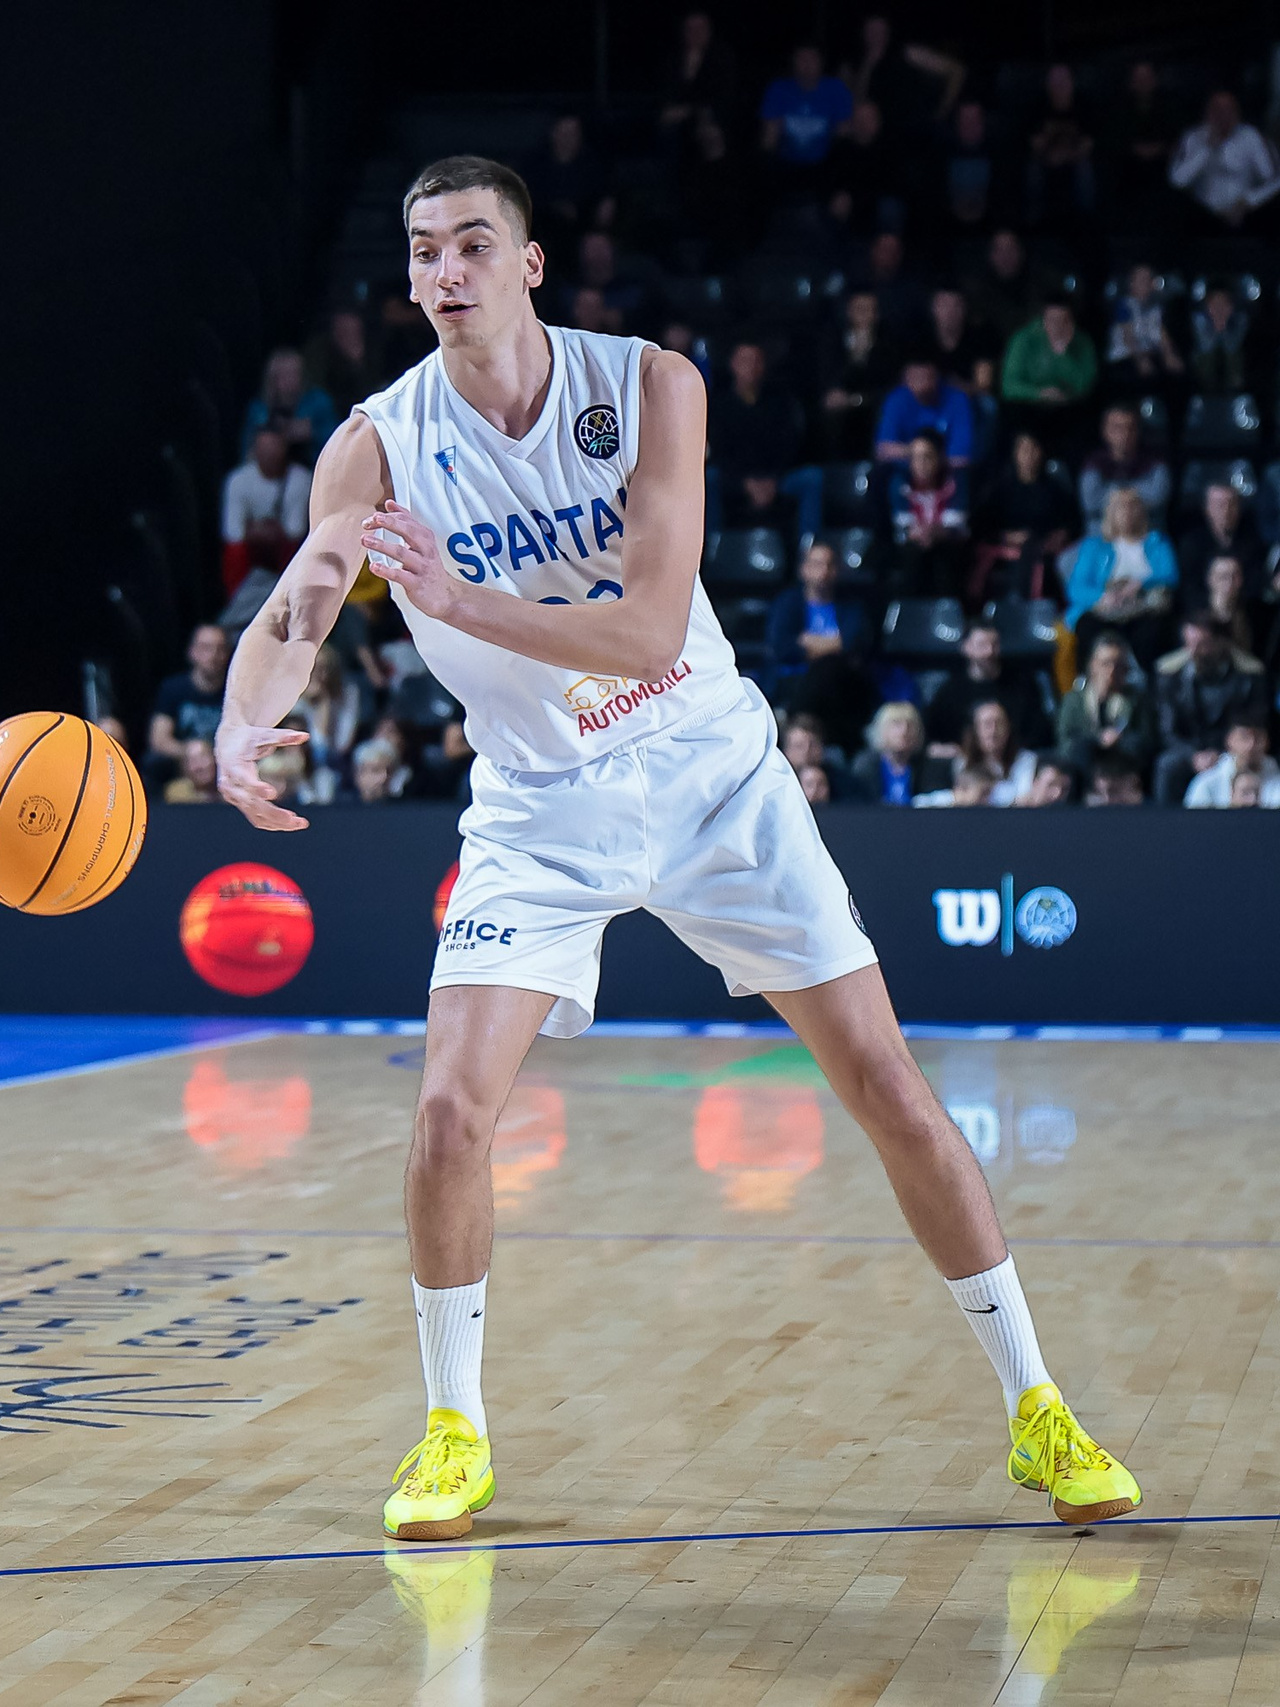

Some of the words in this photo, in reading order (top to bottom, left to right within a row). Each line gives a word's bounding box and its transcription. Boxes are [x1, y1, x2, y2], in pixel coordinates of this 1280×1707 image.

[577, 660, 693, 738] AUTOMOILI
[77, 822, 111, 882] CHAMPIONS
[445, 942, 475, 952] SHOES
